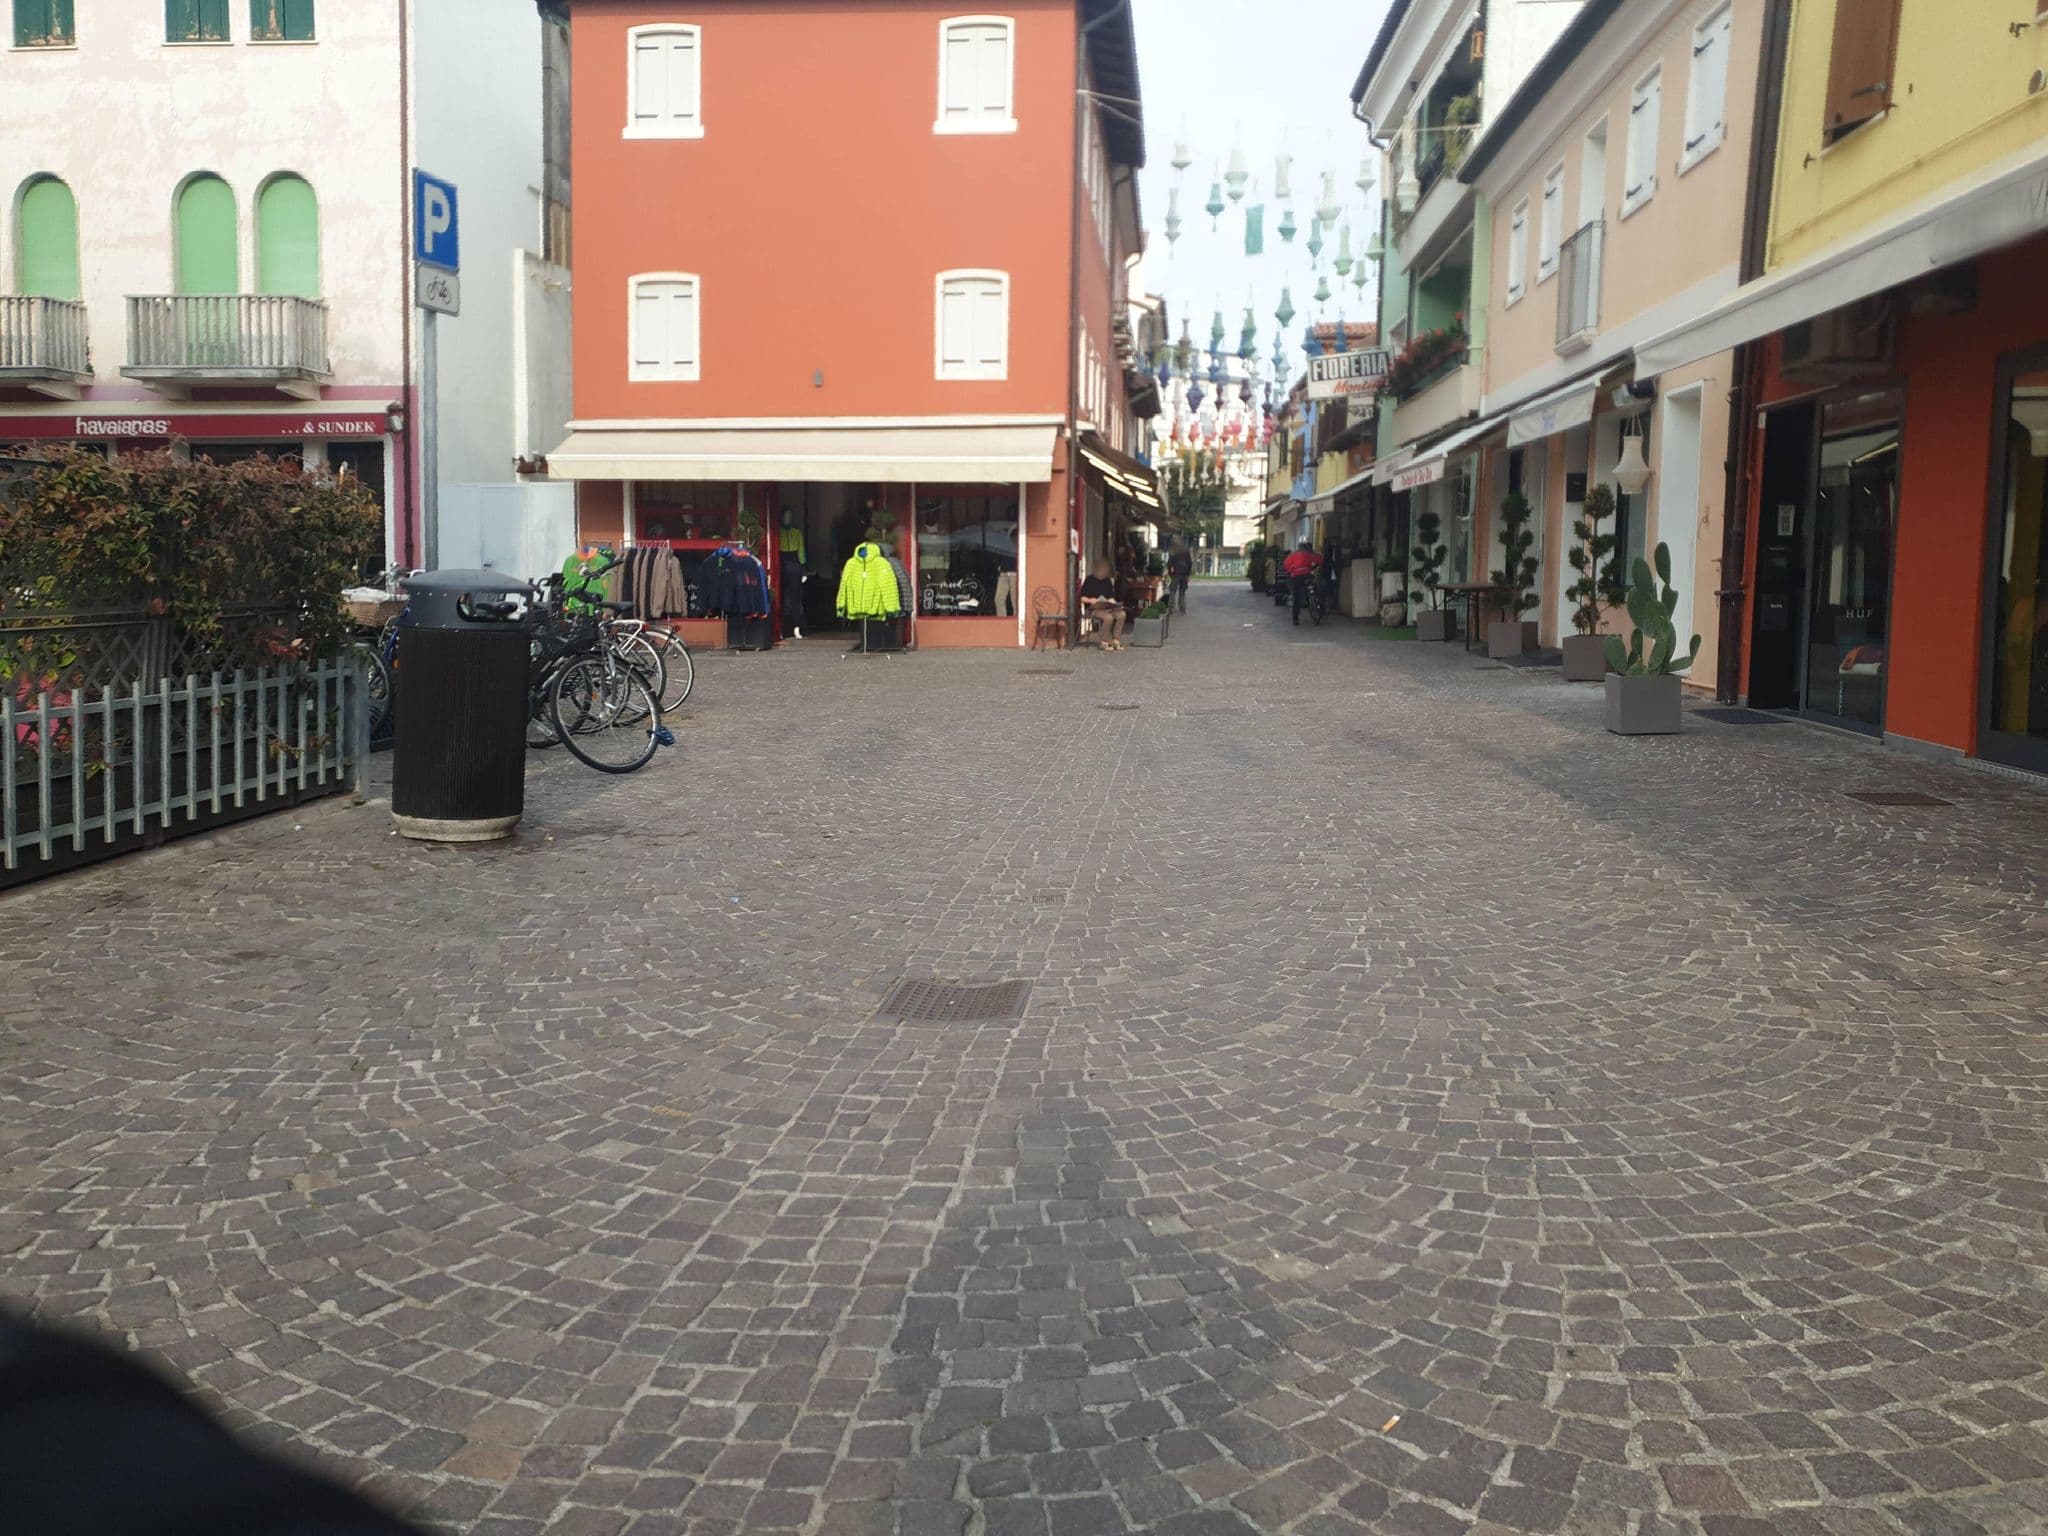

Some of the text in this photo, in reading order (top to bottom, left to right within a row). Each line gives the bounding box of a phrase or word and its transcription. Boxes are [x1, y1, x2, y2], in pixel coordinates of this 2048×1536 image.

[424, 182, 451, 253] P
[1312, 352, 1388, 382] FIORERIA
[75, 416, 168, 436] havaianas
[317, 420, 375, 433] SUNDEK
